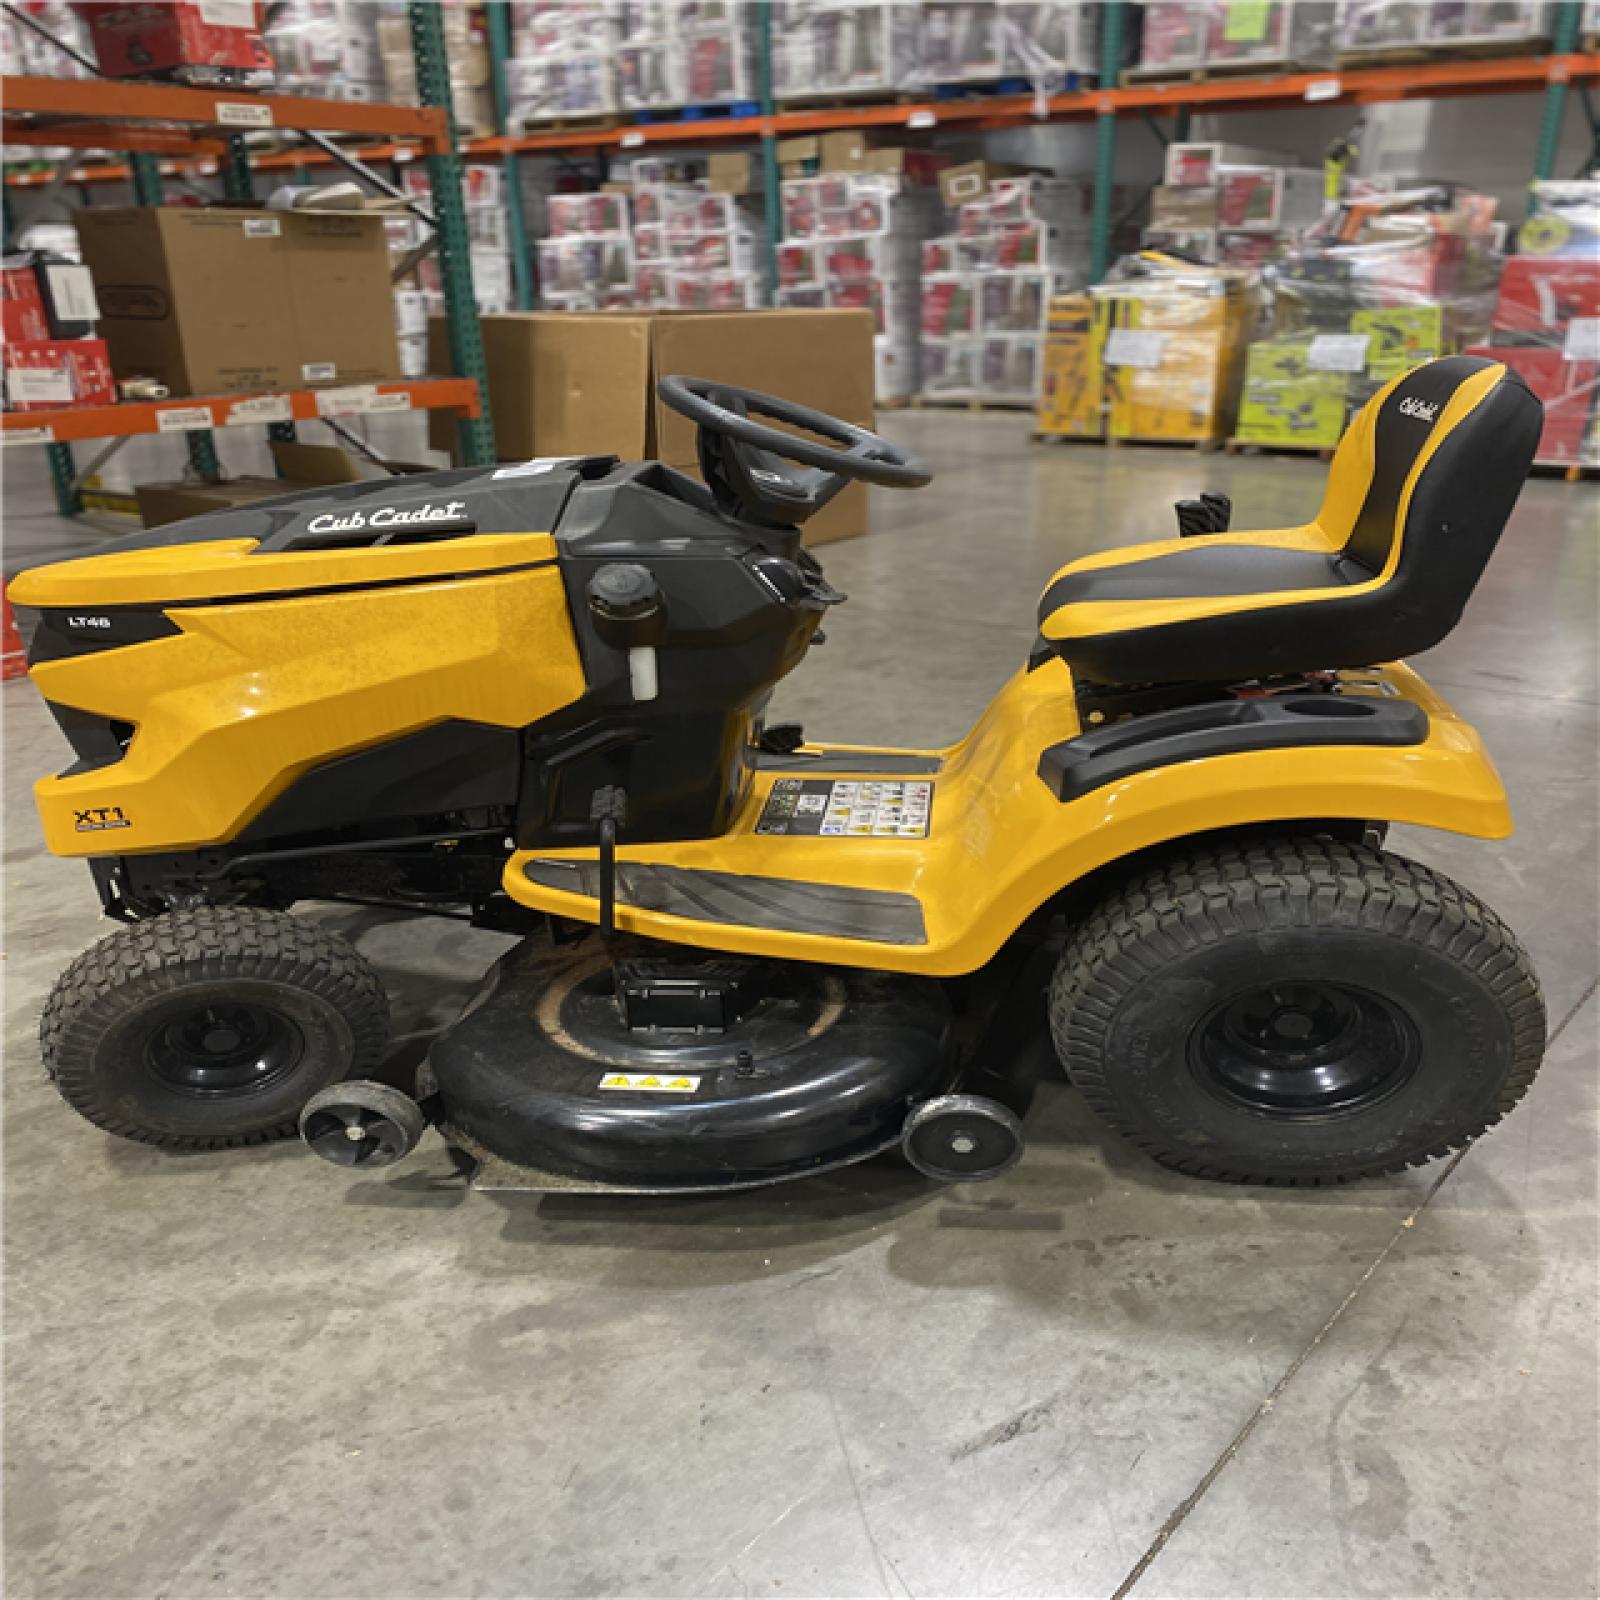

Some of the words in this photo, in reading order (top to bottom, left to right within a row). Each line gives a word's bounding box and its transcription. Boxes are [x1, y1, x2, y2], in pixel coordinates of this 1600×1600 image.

[307, 511, 366, 533] Cub
[369, 502, 465, 526] Cadet
[74, 807, 123, 824] XT1
